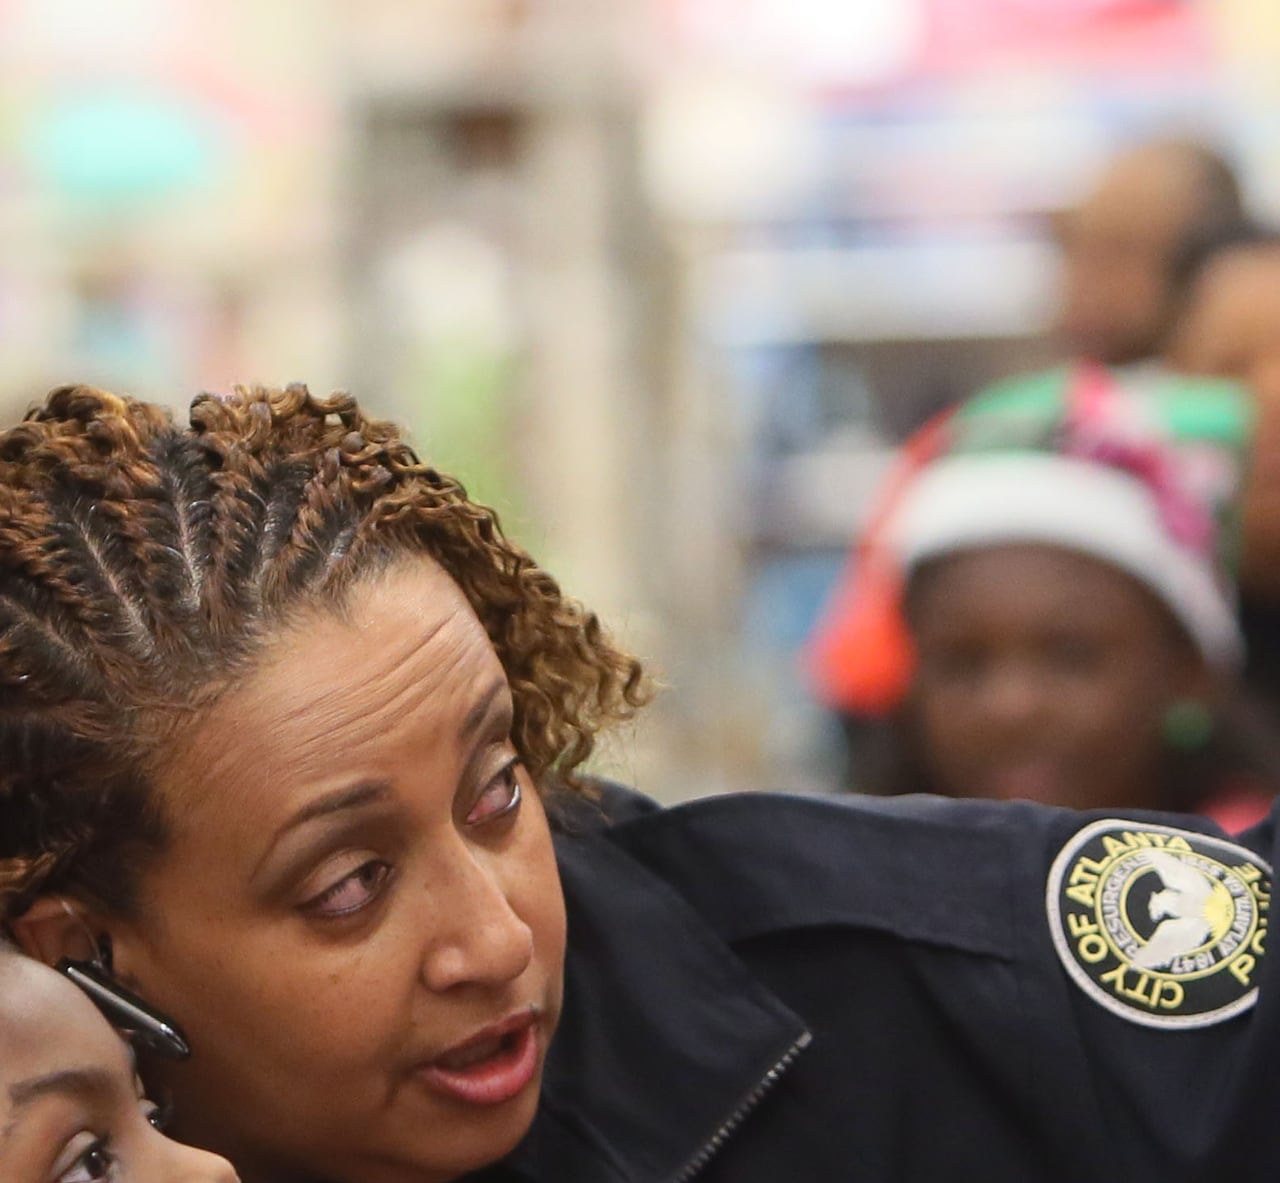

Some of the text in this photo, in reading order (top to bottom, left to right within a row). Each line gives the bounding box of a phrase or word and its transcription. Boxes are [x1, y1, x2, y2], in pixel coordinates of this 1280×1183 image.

[1065, 832, 1193, 1009] CITY OF ATLANTA
